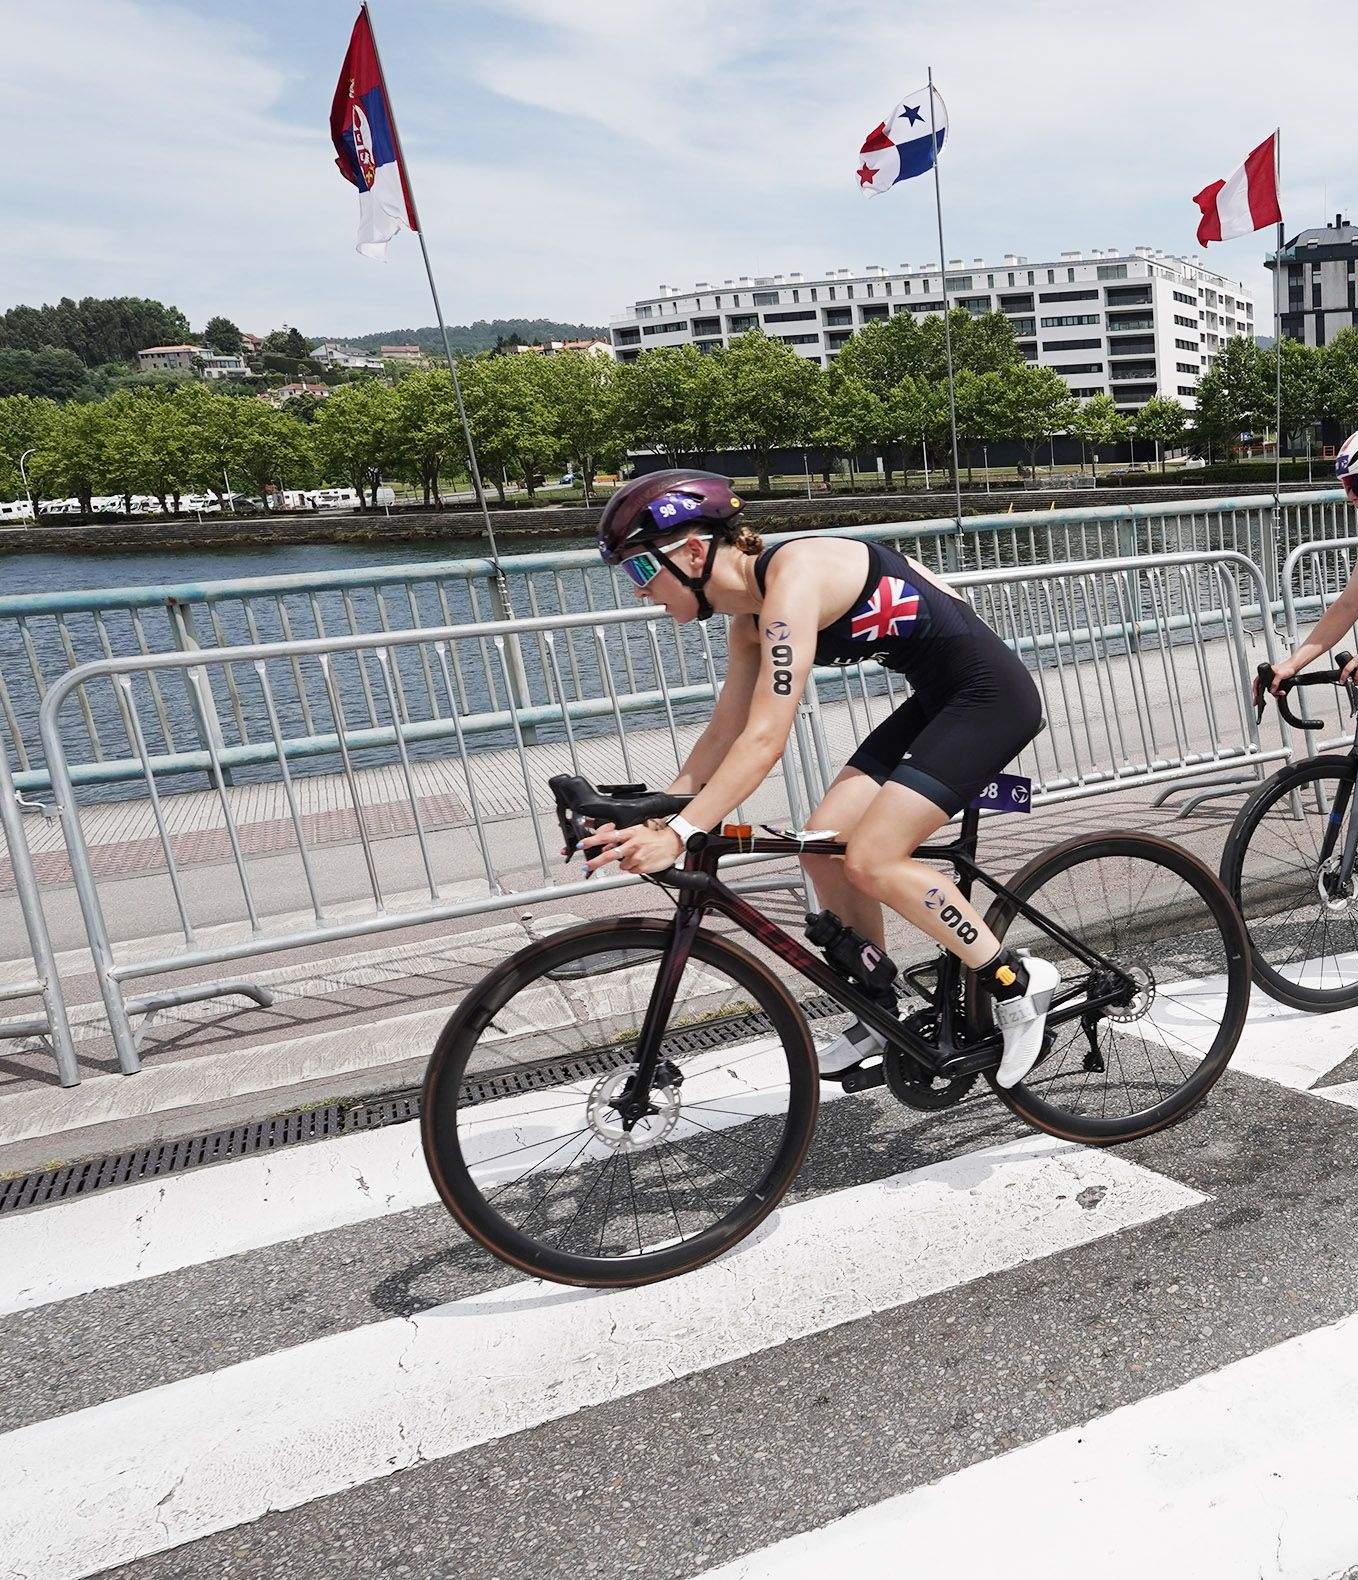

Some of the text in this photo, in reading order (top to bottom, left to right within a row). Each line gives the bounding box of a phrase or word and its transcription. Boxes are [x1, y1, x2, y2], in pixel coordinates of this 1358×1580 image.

[659, 503, 677, 518] 98
[771, 644, 794, 696] 98
[940, 904, 979, 945] 98
